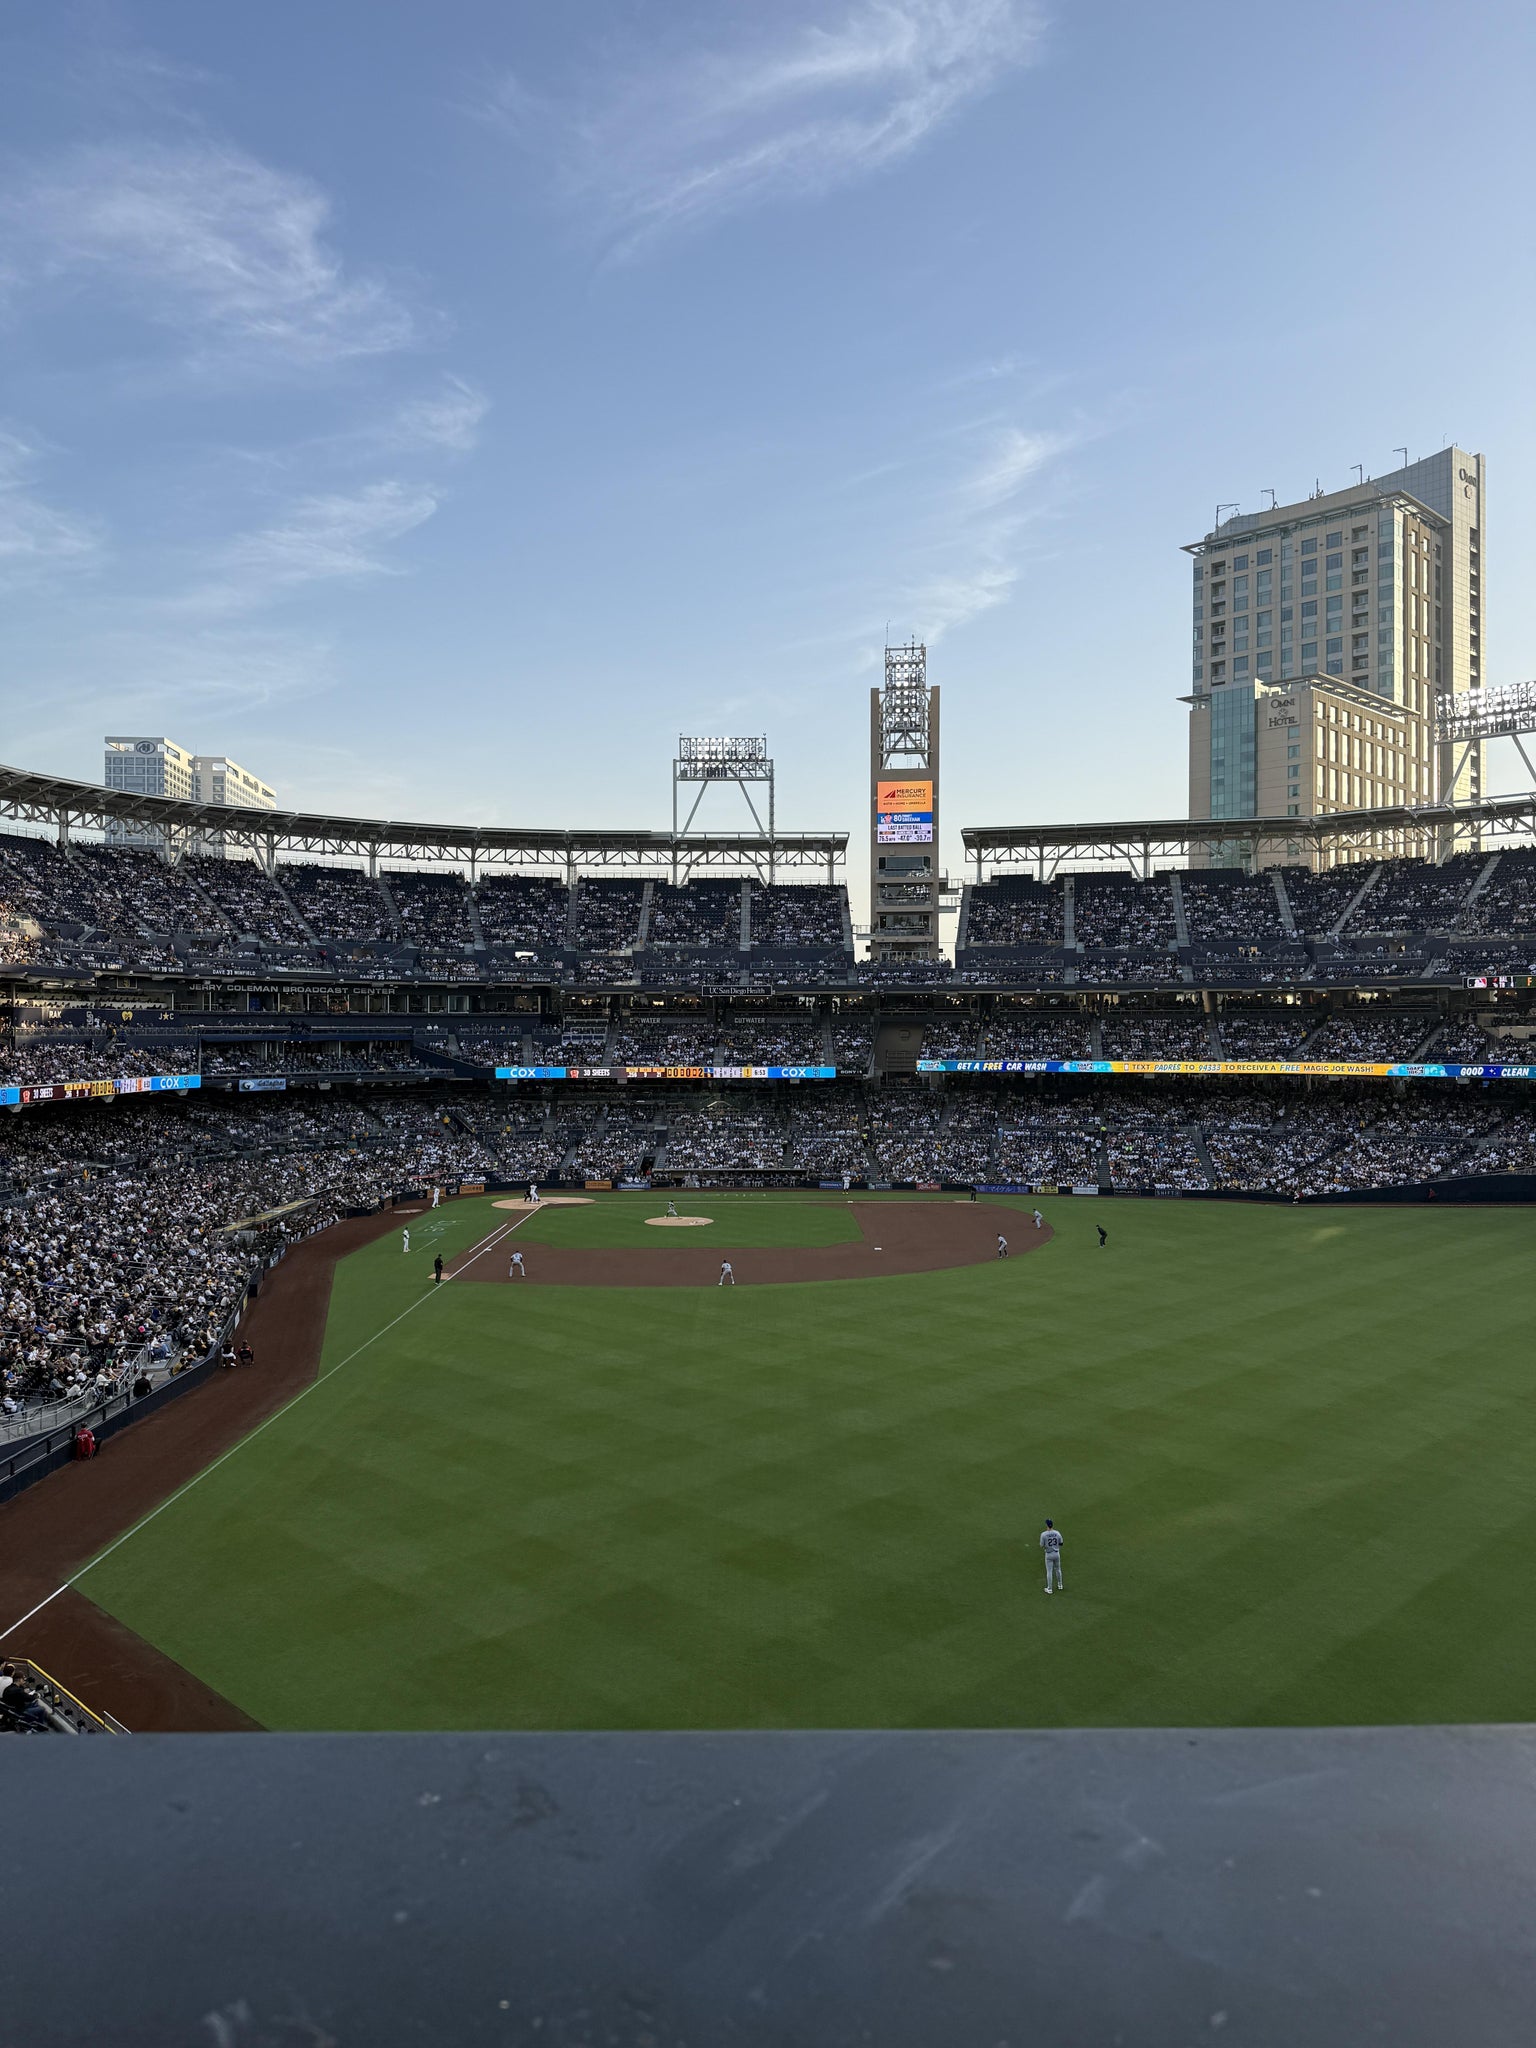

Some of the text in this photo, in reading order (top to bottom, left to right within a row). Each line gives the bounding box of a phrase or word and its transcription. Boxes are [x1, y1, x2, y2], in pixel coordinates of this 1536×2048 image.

[1270, 698, 1296, 709] OMNI
[1269, 716, 1298, 727] HOTEL
[893, 814, 902, 822] 80
[189, 983, 396, 995] JERRY COLEMAN BROADCAST CENTER
[730, 987, 746, 995] Diego
[48, 1010, 62, 1019] RAK
[956, 1062, 1048, 1071] GET A FREE CAR WASH
[1460, 1066, 1530, 1077] GOOD CLEAN
[510, 1068, 536, 1078] COX
[592, 1068, 611, 1076] SHEETS
[698, 1067, 704, 1078] 2
[781, 1068, 806, 1078] COX
[160, 1077, 180, 1088] COX
[1048, 1537, 1058, 1547] 23
